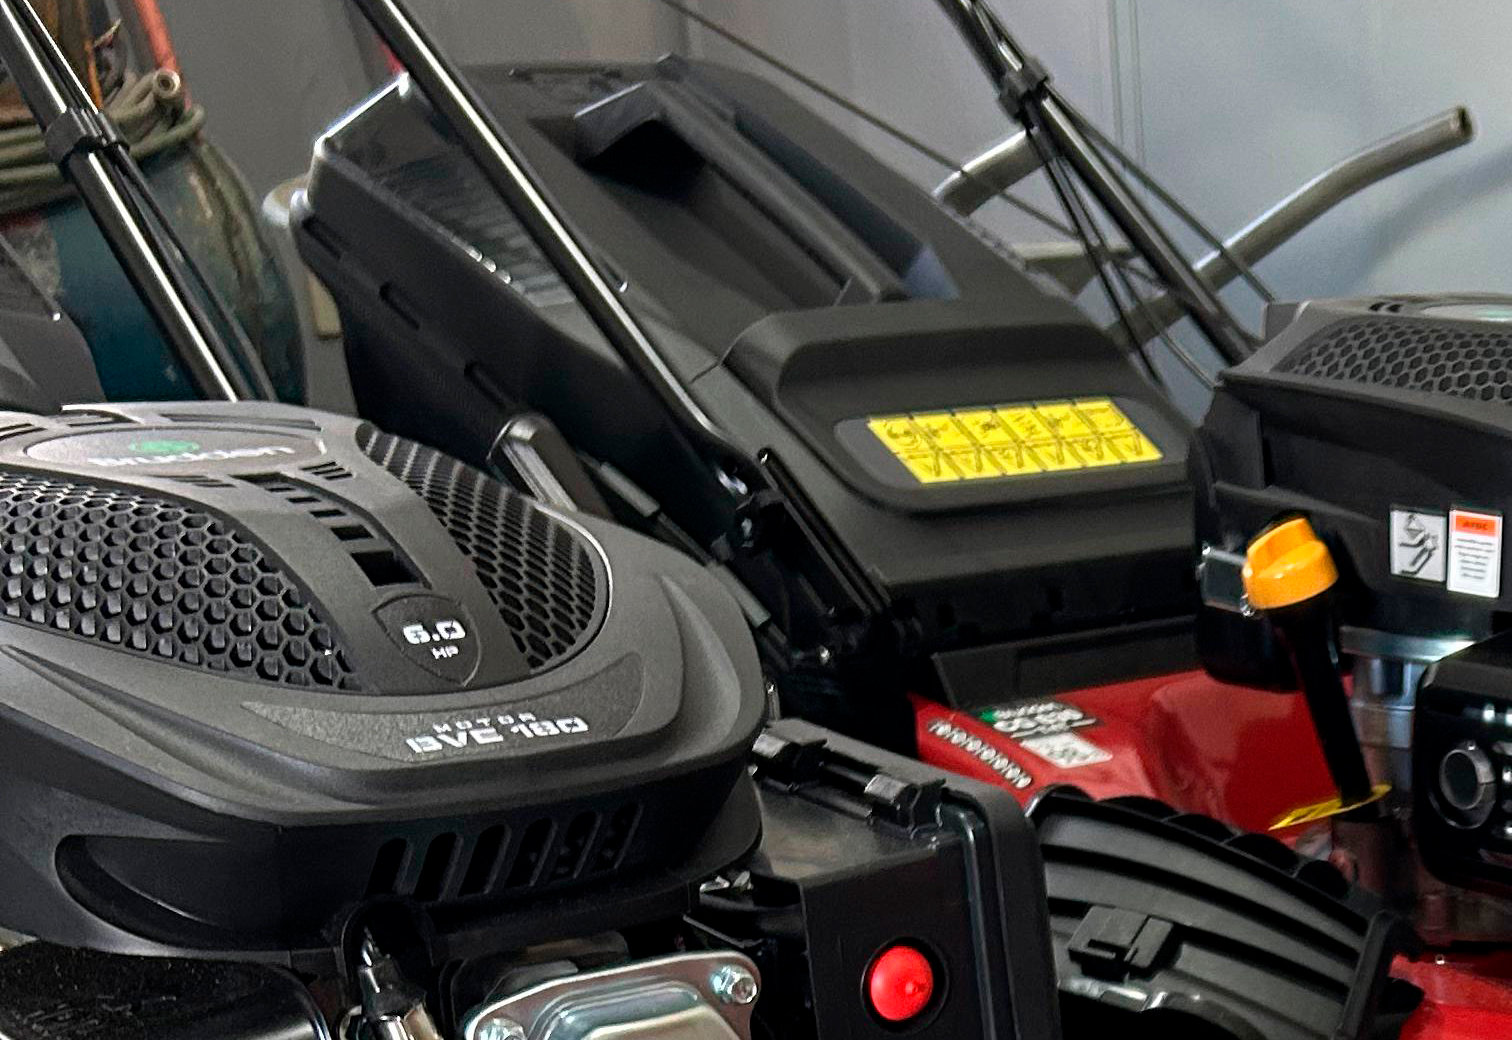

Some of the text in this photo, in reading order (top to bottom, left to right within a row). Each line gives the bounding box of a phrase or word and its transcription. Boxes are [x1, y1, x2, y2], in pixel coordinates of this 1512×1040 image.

[402, 619, 466, 645] 6.0
[431, 645, 459, 660] HP
[432, 712, 536, 734] MOTOR
